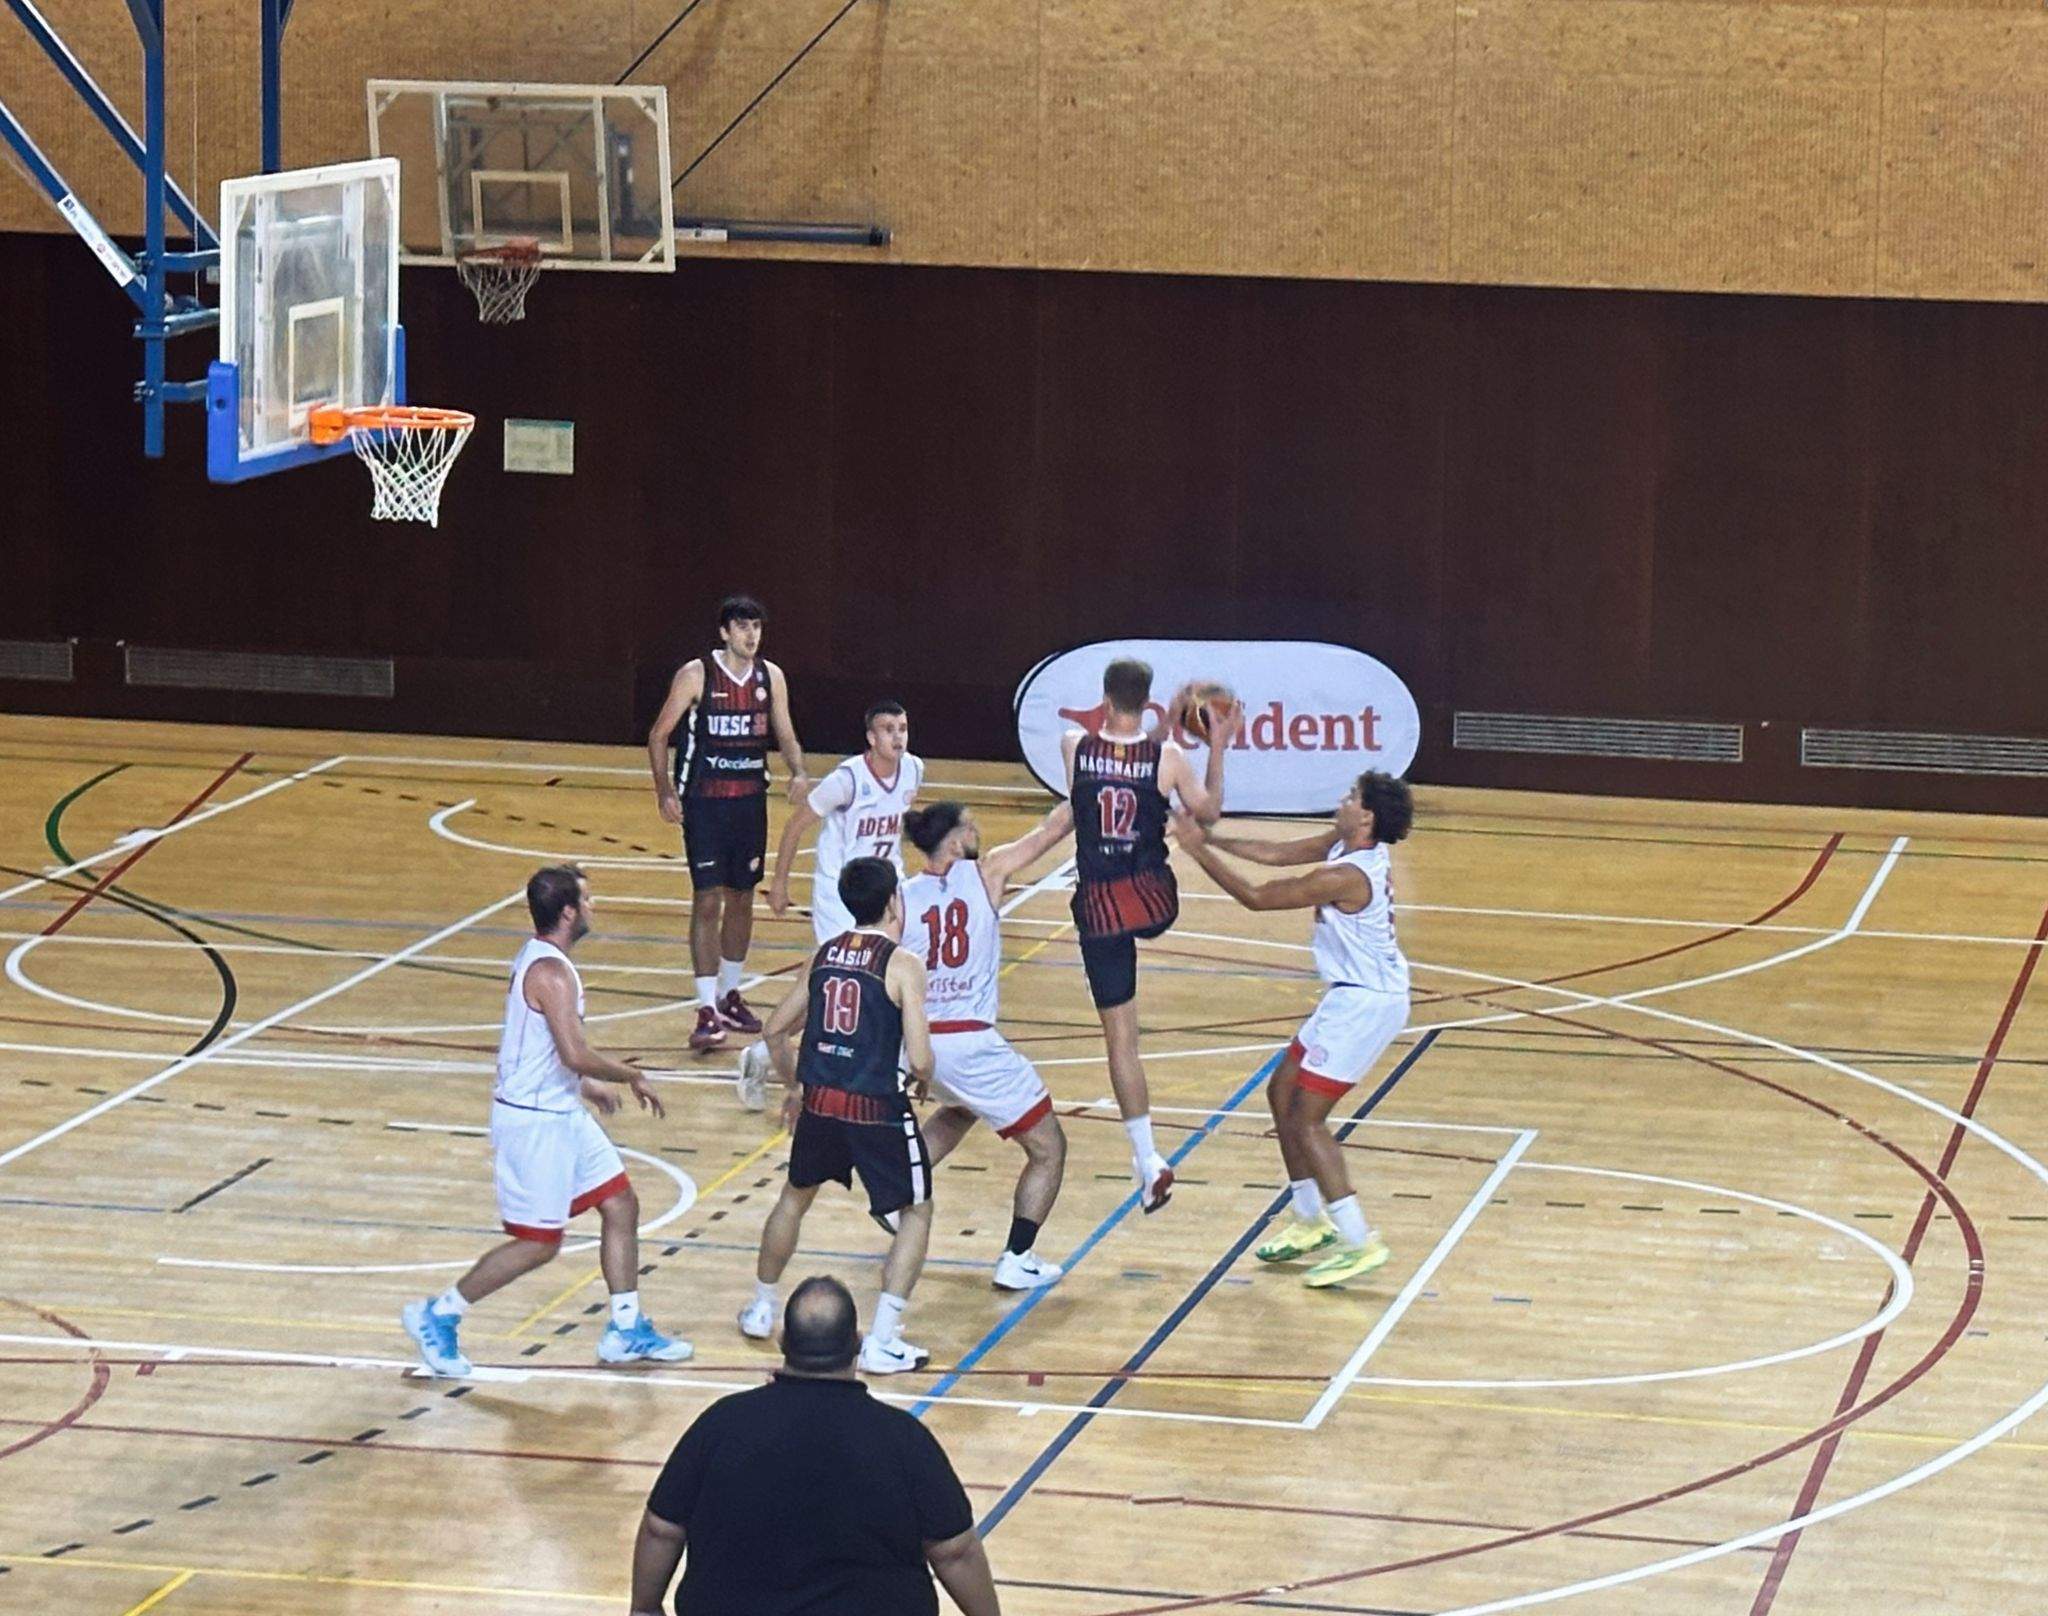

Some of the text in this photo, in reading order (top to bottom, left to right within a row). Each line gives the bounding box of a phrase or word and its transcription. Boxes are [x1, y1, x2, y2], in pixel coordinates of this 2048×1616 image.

[707, 714, 751, 736] UESC
[856, 813, 900, 840] ADEM
[1098, 786, 1140, 838] 12
[921, 897, 969, 971] 18
[823, 976, 861, 1036] 19
